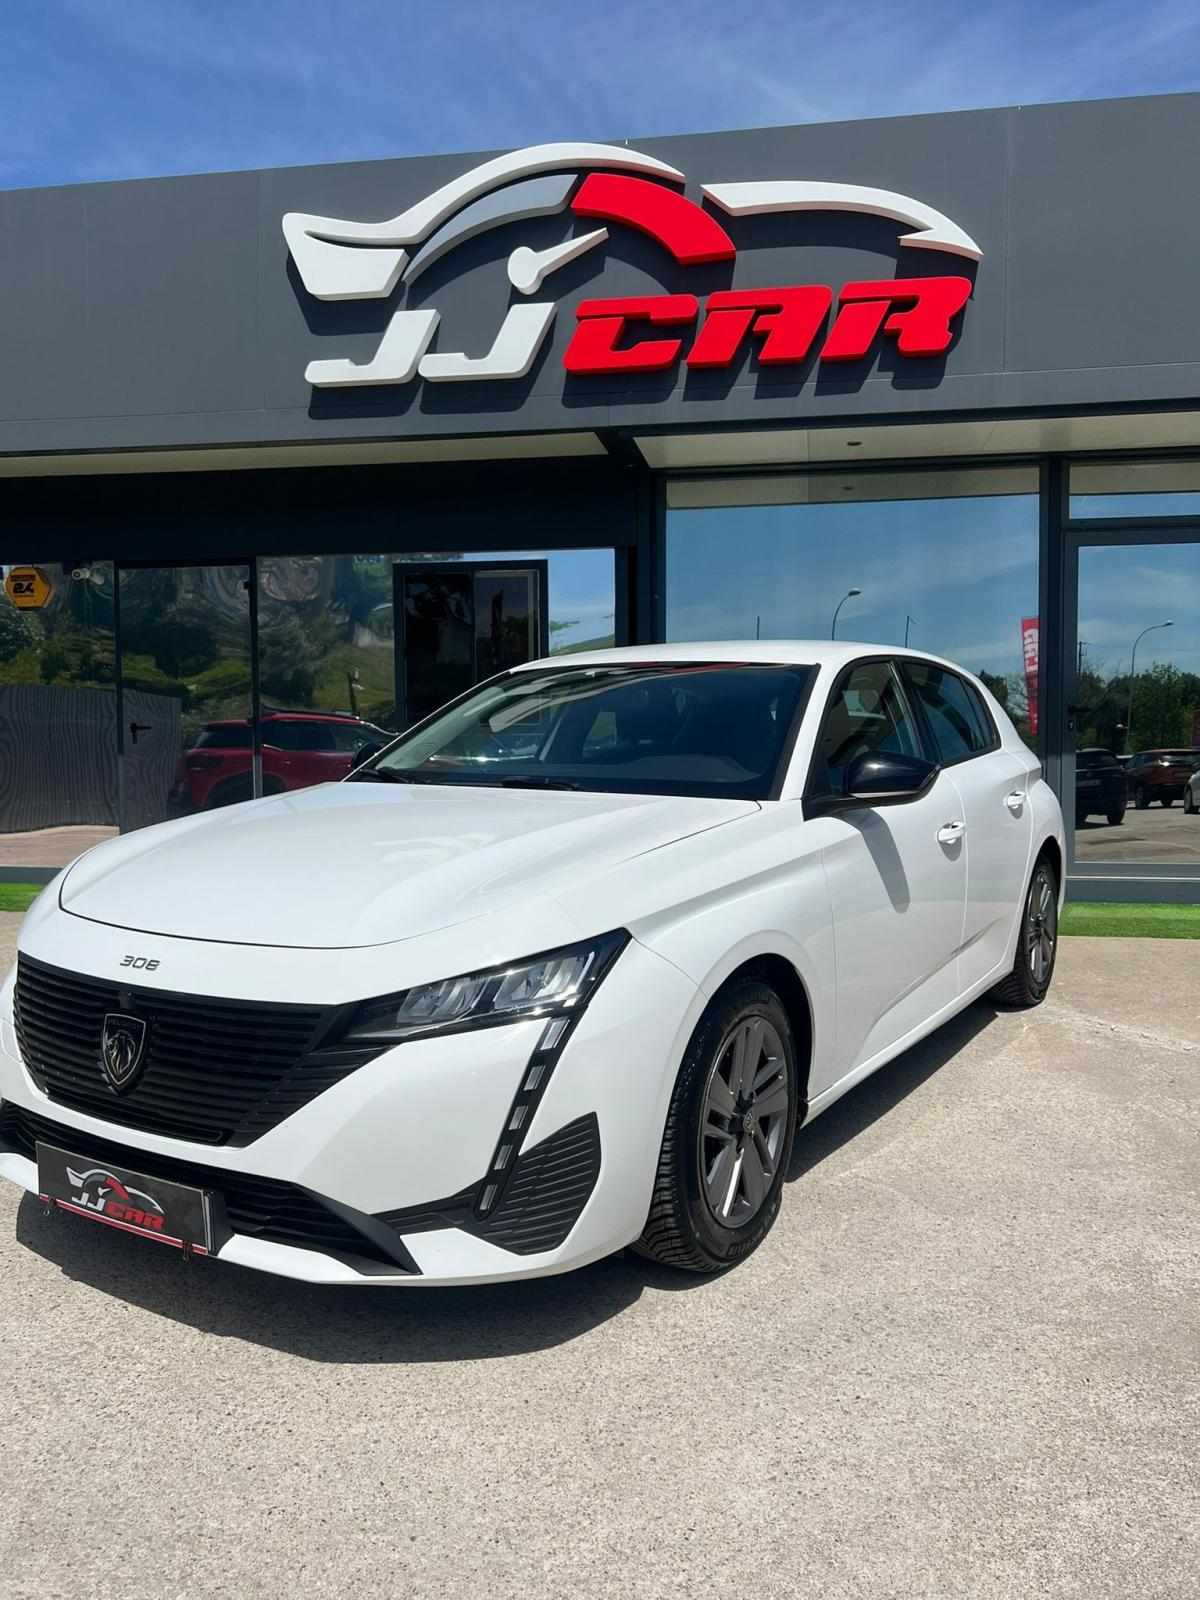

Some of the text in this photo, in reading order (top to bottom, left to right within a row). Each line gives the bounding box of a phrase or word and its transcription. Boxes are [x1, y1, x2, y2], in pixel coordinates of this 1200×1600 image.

[563, 276, 972, 374] CAR
[119, 955, 160, 971] 308
[106, 1201, 165, 1231] CAR
